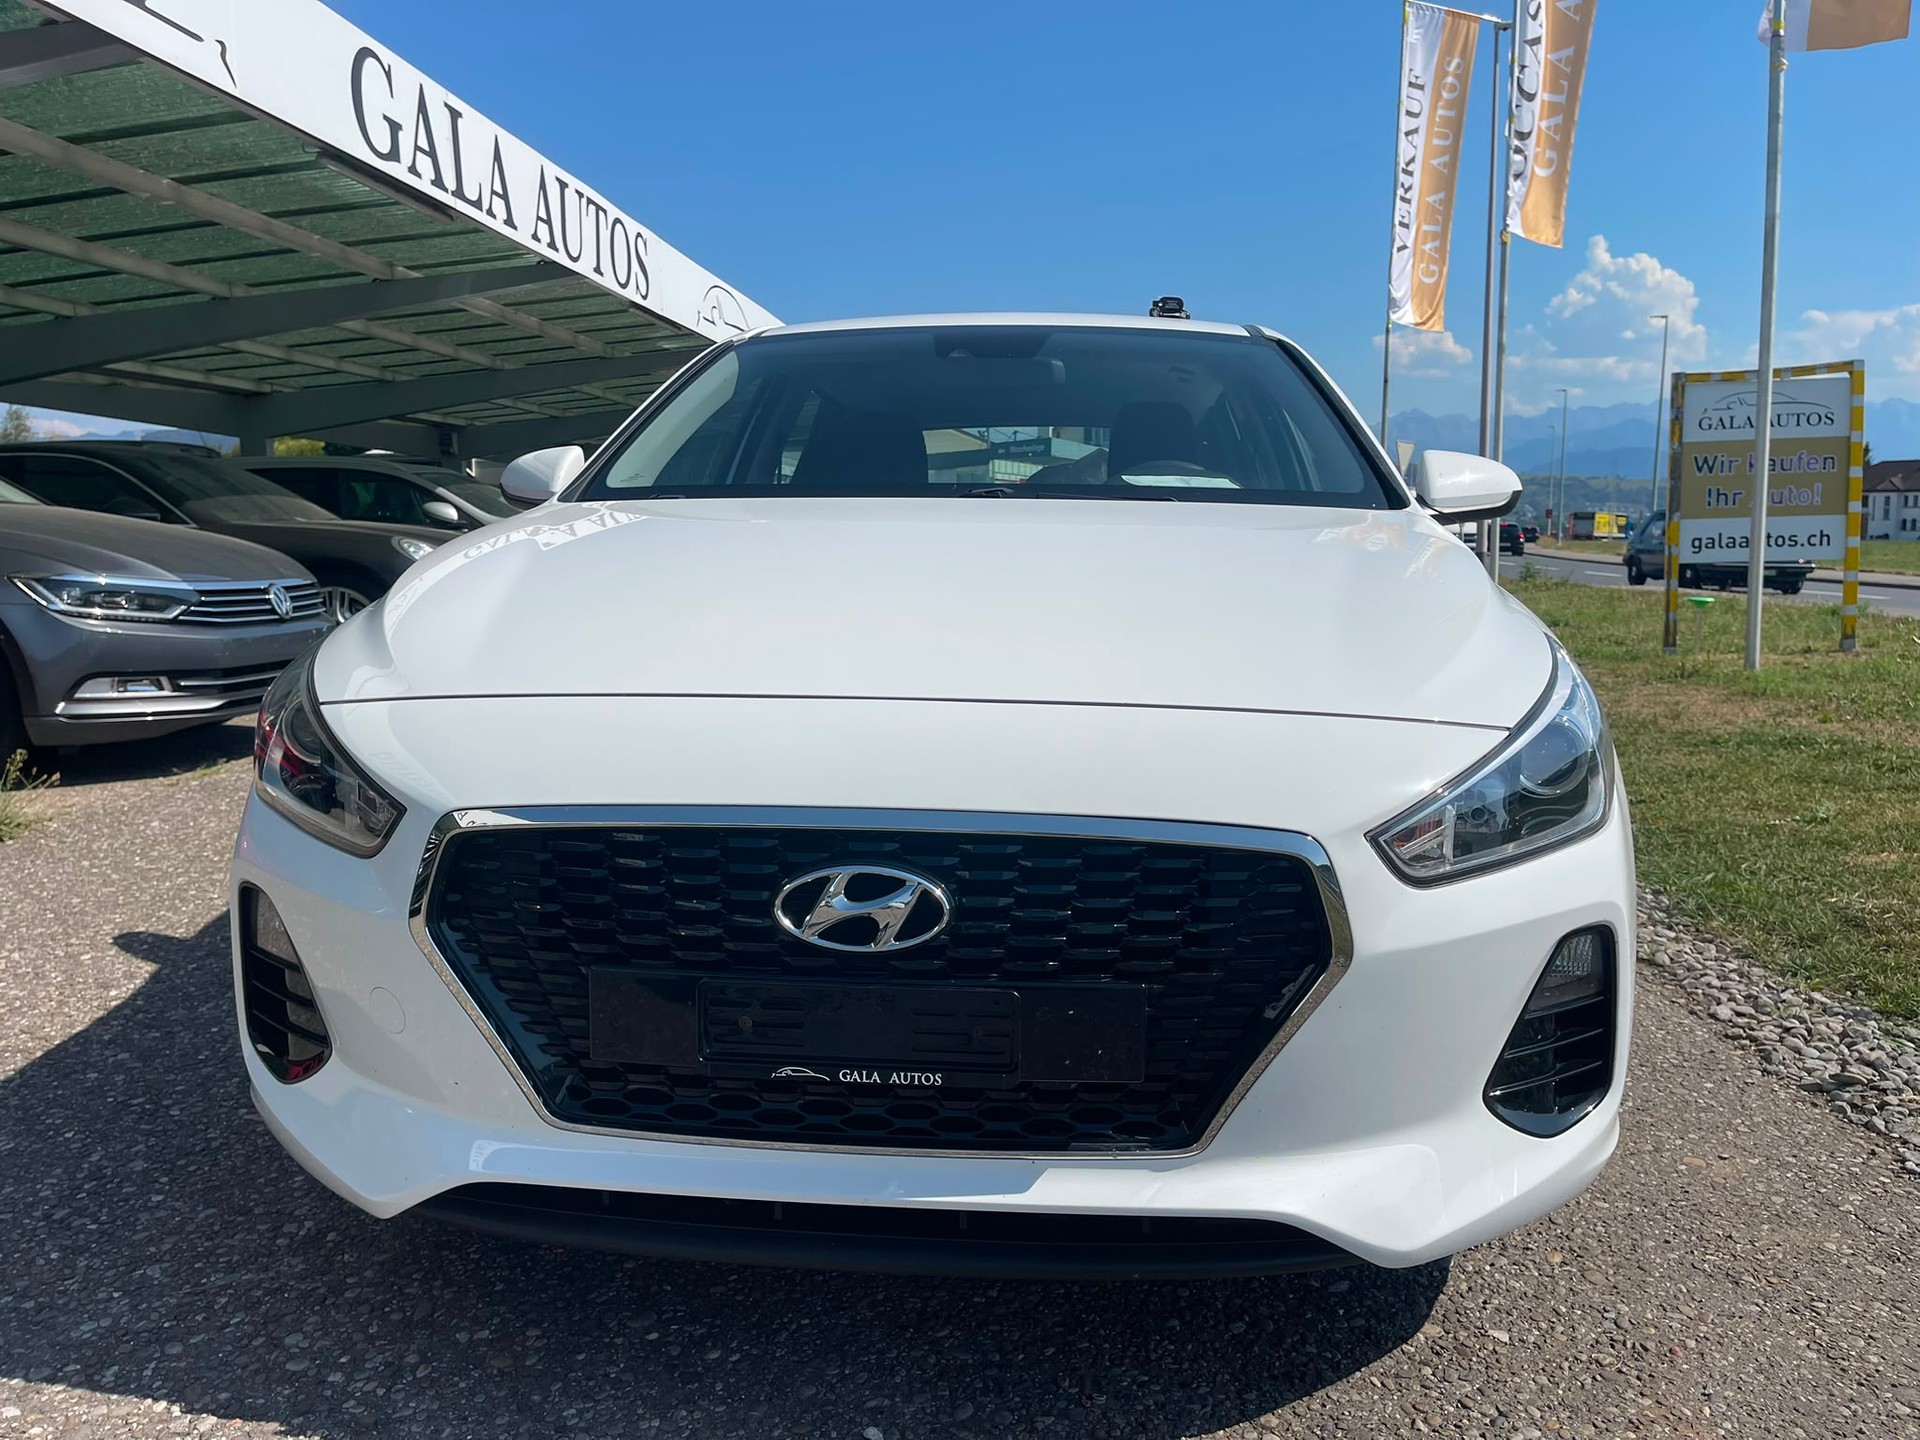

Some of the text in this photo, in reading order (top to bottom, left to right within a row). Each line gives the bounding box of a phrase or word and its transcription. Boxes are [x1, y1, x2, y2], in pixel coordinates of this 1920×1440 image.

[1534, 45, 1575, 177] GALA
[1396, 68, 1426, 254] VERKAUF
[1418, 56, 1464, 285] GALA AUTOS
[351, 47, 650, 300] GALA AUTOS
[1698, 415, 1755, 431] GALA
[1693, 454, 1739, 475] Wir
[1707, 485, 1821, 507] Ihr uto!
[1691, 530, 1831, 554] galaatos.ch
[838, 1069, 943, 1086] GALA AUTOS
